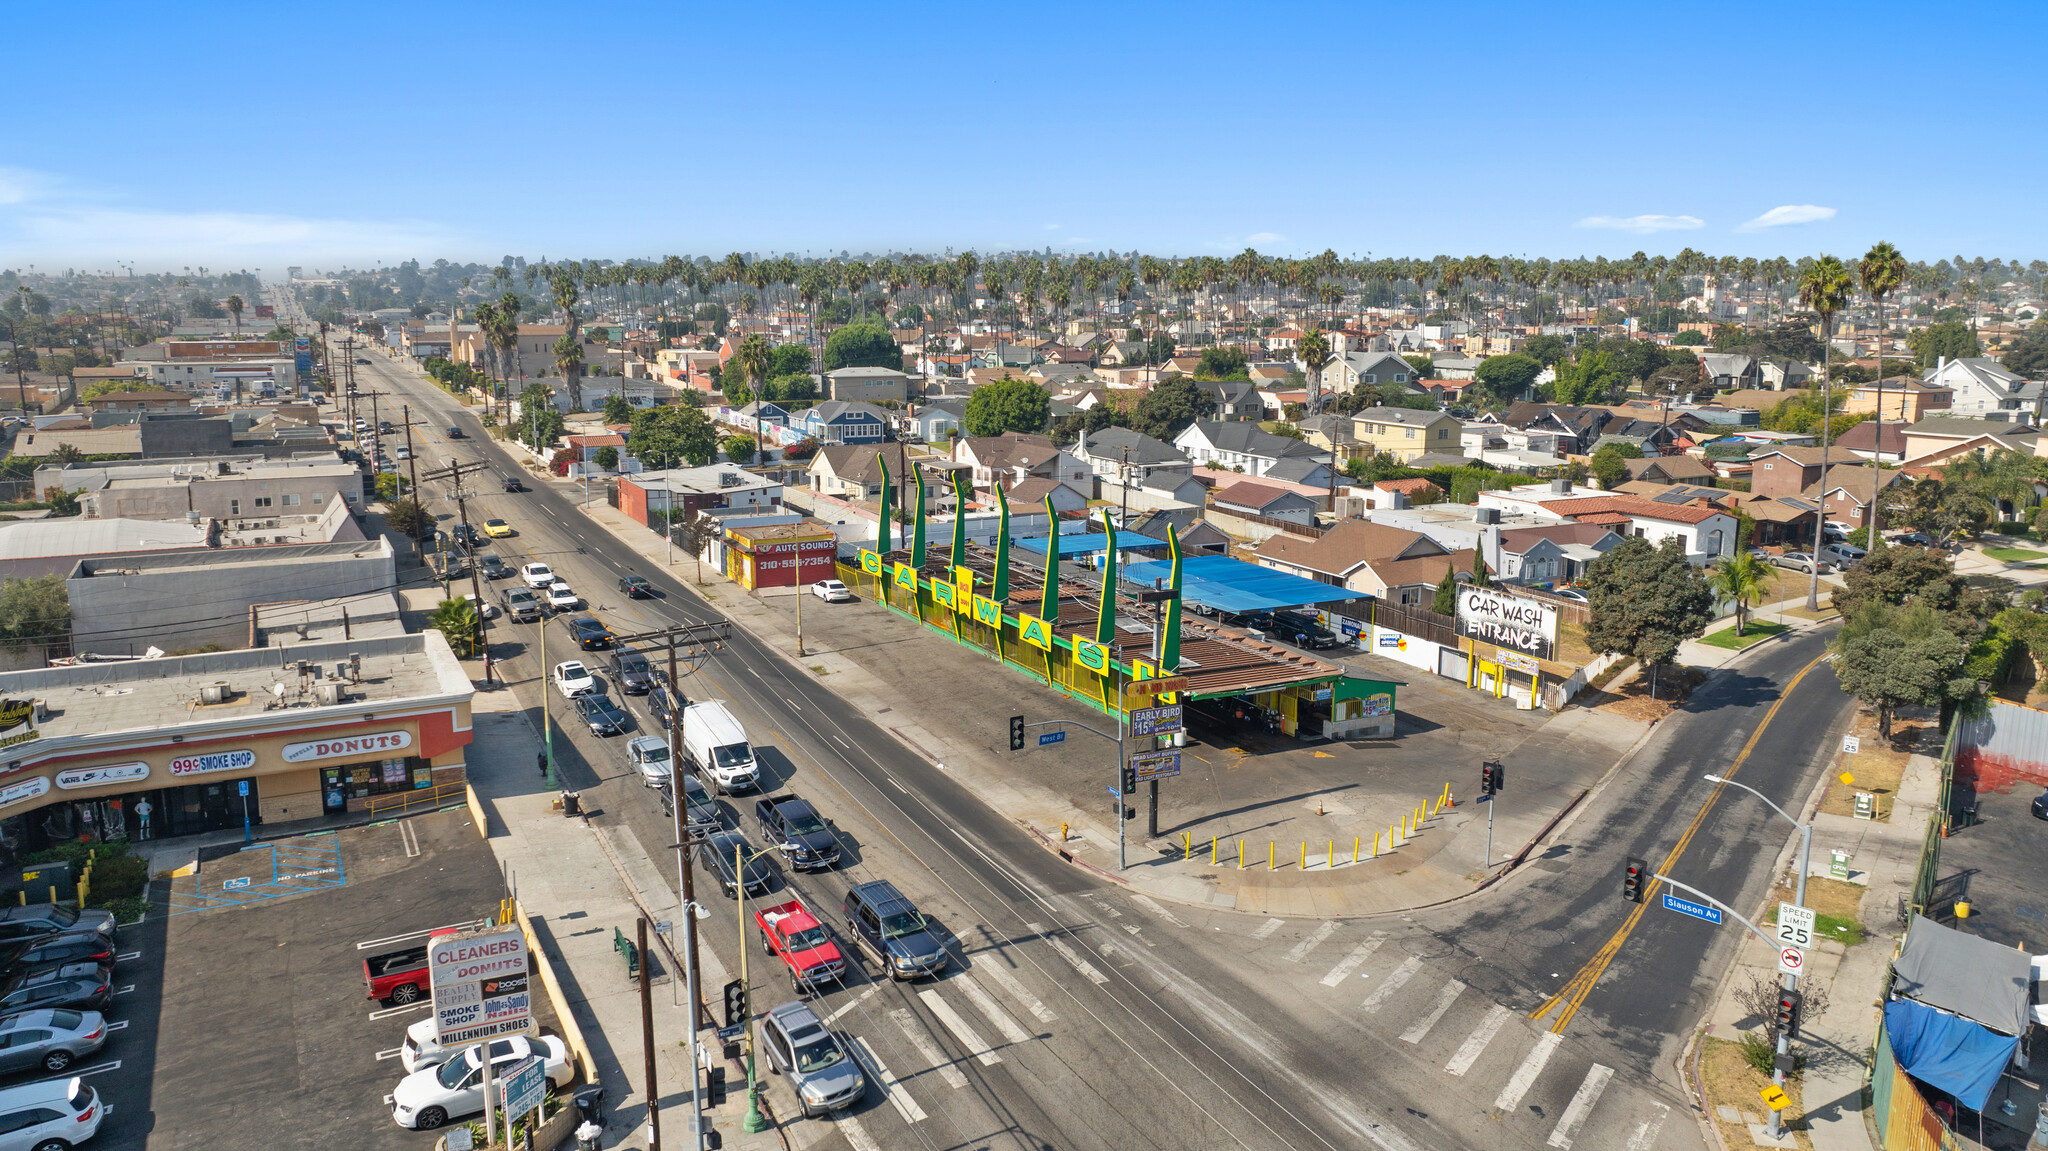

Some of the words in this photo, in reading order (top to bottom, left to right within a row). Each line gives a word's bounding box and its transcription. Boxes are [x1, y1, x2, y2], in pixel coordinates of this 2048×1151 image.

[775, 543, 796, 552] AUTO
[800, 541, 834, 550] SOUNDS
[864, 552, 954, 608] CAR
[1469, 594, 1499, 618] CAR
[1502, 602, 1543, 628] WASH
[1468, 620, 1541, 650] ENTRANCE
[1136, 710, 1160, 721] EARLY
[1162, 707, 1180, 718] BIRD
[316, 735, 402, 756] DONUTS
[1041, 734, 1056, 743] West
[1845, 744, 1857, 752] 25
[200, 754, 229, 771] SMOKE
[231, 752, 252, 767] SHOP
[61, 776, 80, 784] VANS
[295, 867, 335, 879] PARKING
[1668, 898, 1703, 915] Slauson
[1706, 910, 1717, 919] Av
[1783, 906, 1812, 919] SPEED
[1784, 915, 1807, 927] LIMIT
[1781, 925, 1808, 944] 25
[437, 939, 519, 964] CLEANERS
[458, 958, 523, 978] DONUTS
[499, 977, 527, 988] boost
[437, 983, 476, 997] BEAUTY
[437, 992, 476, 1006] SUPPLY
[440, 1004, 480, 1018] SMOKE
[445, 1013, 476, 1026] SHOP
[441, 1024, 498, 1045] MILLENNIUM
[500, 1019, 529, 1033] SHOES
[525, 1065, 539, 1080] FOR
[522, 1072, 543, 1092] LEASE
